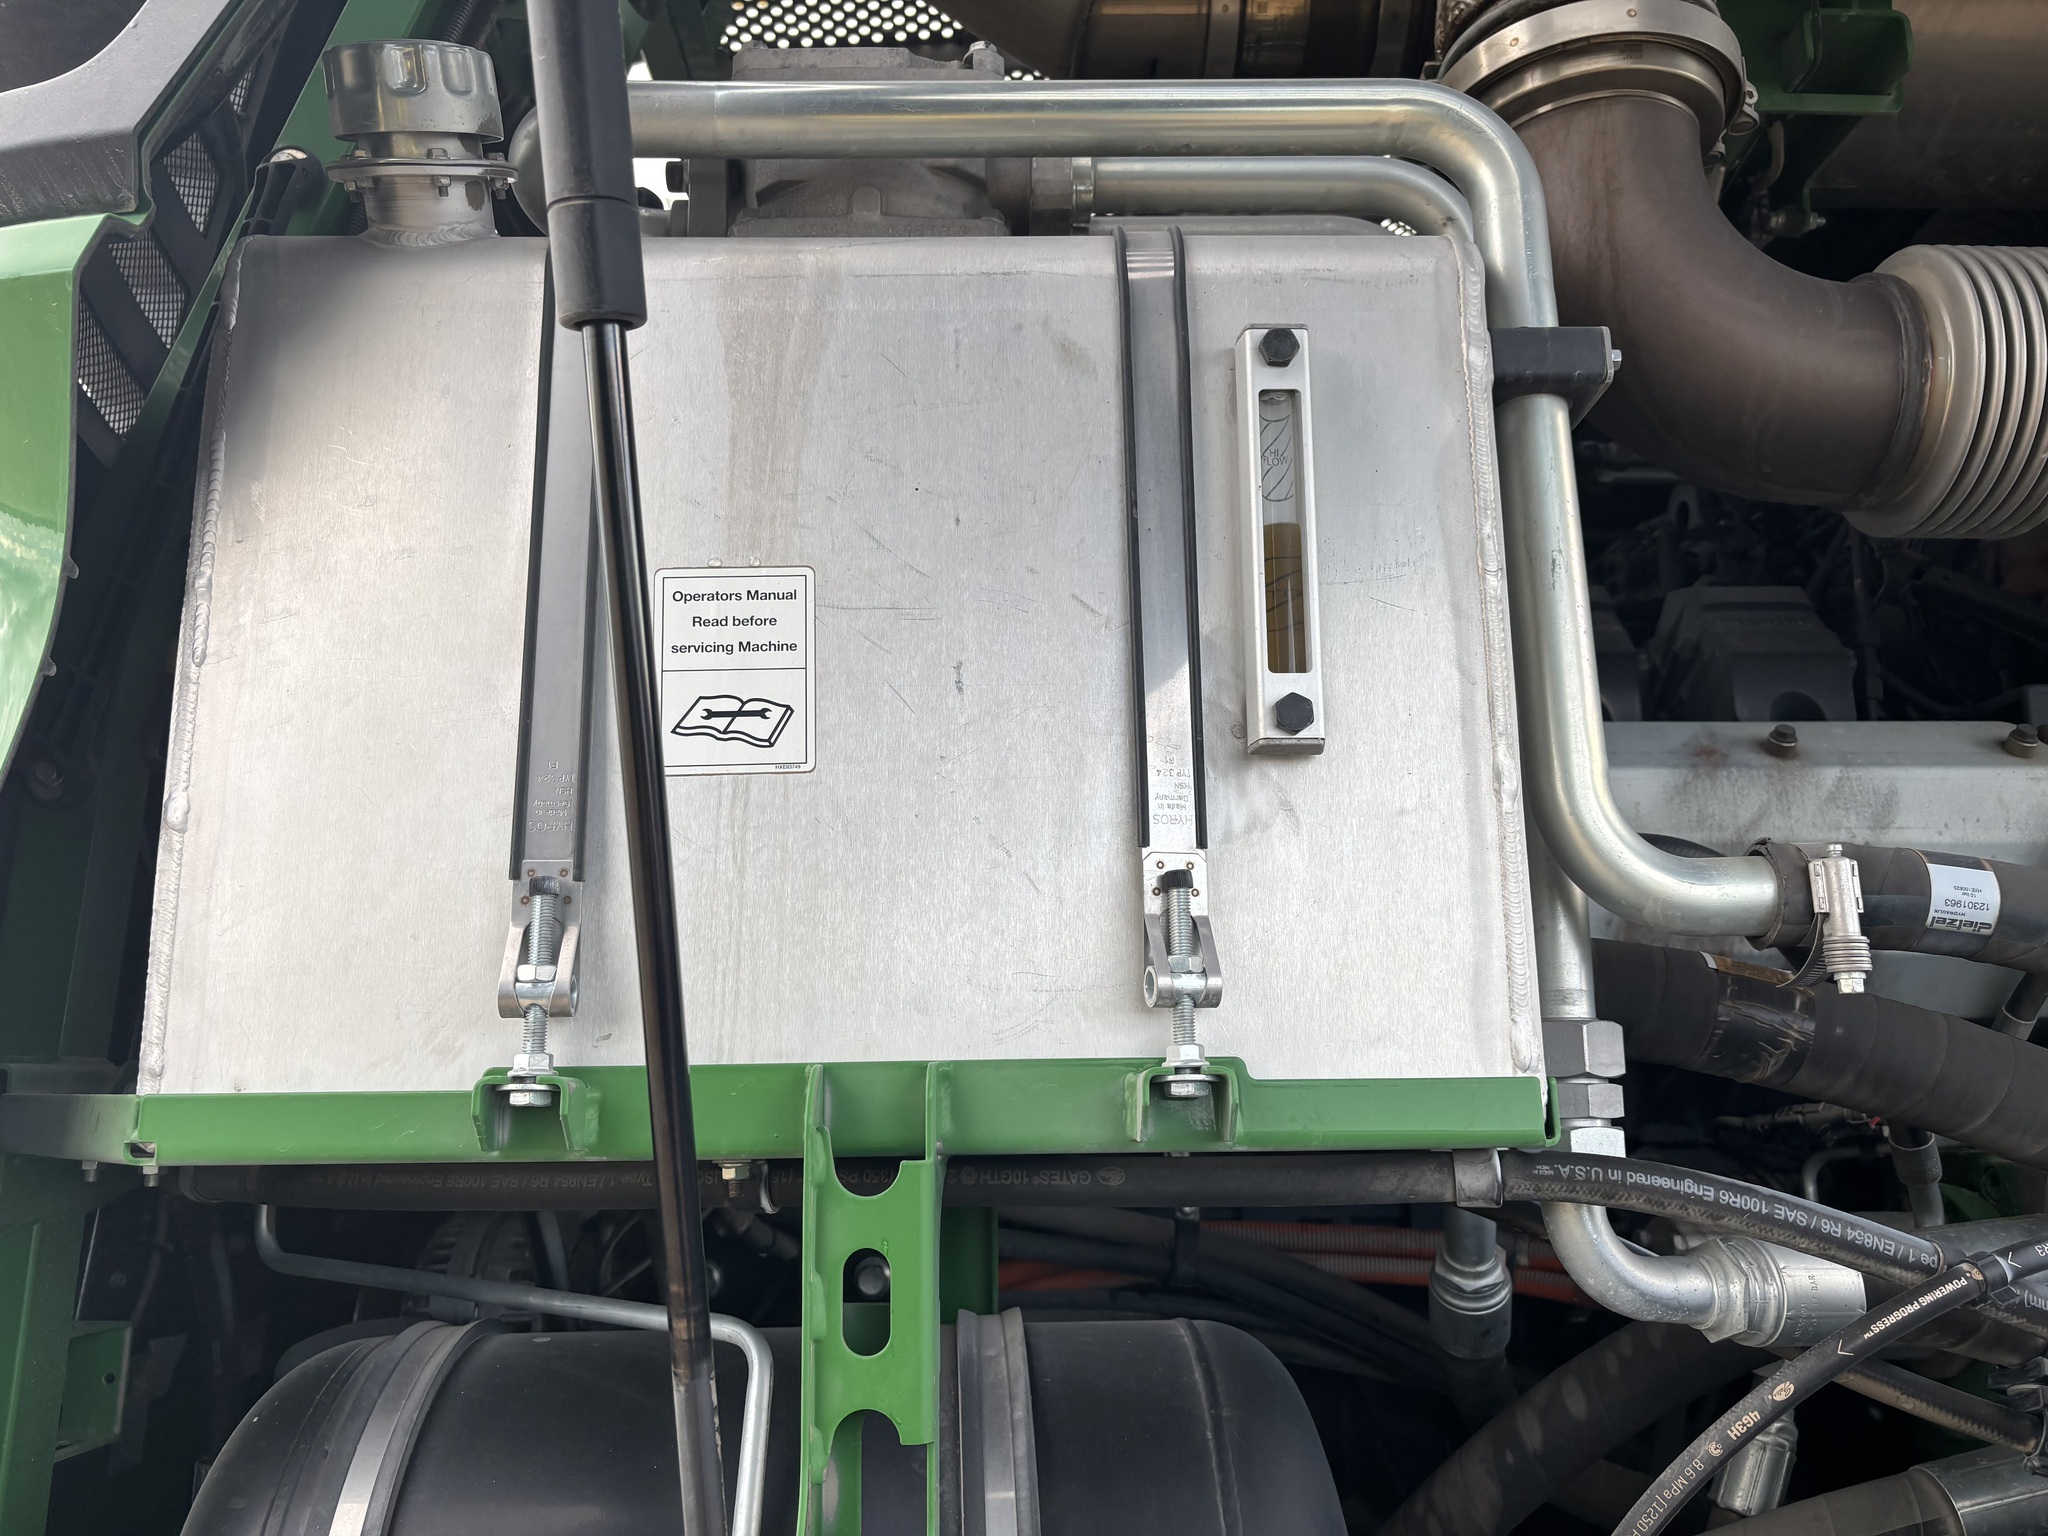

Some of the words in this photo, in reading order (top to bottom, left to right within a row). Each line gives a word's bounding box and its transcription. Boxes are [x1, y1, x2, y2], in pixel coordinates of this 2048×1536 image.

[1269, 448, 1279, 458] HI
[672, 590, 743, 604] Operators
[746, 589, 797, 601] Manual
[692, 616, 729, 627] Read
[732, 615, 778, 627] before
[671, 641, 734, 655] servicing
[738, 640, 798, 653] Machine
[1152, 814, 1193, 825] HYROS
[1934, 908, 1966, 917] HYDRAULIK
[1944, 898, 1990, 911] 12301963
[1929, 916, 1993, 933] dietzel
[1554, 1164, 1603, 1181] U.S.A.
[1608, 1168, 1623, 1184] in
[489, 1174, 519, 1188] SAE
[531, 1174, 550, 1188] R6
[553, 1174, 598, 1188] EN854
[1626, 1171, 1715, 1201] Engineered
[1719, 1190, 1769, 1215] 100R6
[1773, 1203, 1809, 1226] SAE
[1820, 1218, 1842, 1238] R6
[1846, 1226, 1896, 1256] EN854
[1908, 1248, 1916, 1264] 1
[1920, 1253, 1938, 1269] pe
[1918, 1277, 1969, 1306] POWERING
[1726, 1410, 1762, 1440] 4G3H
[1684, 1458, 1705, 1480] 8.6
[1663, 1475, 1689, 1499] MPa
